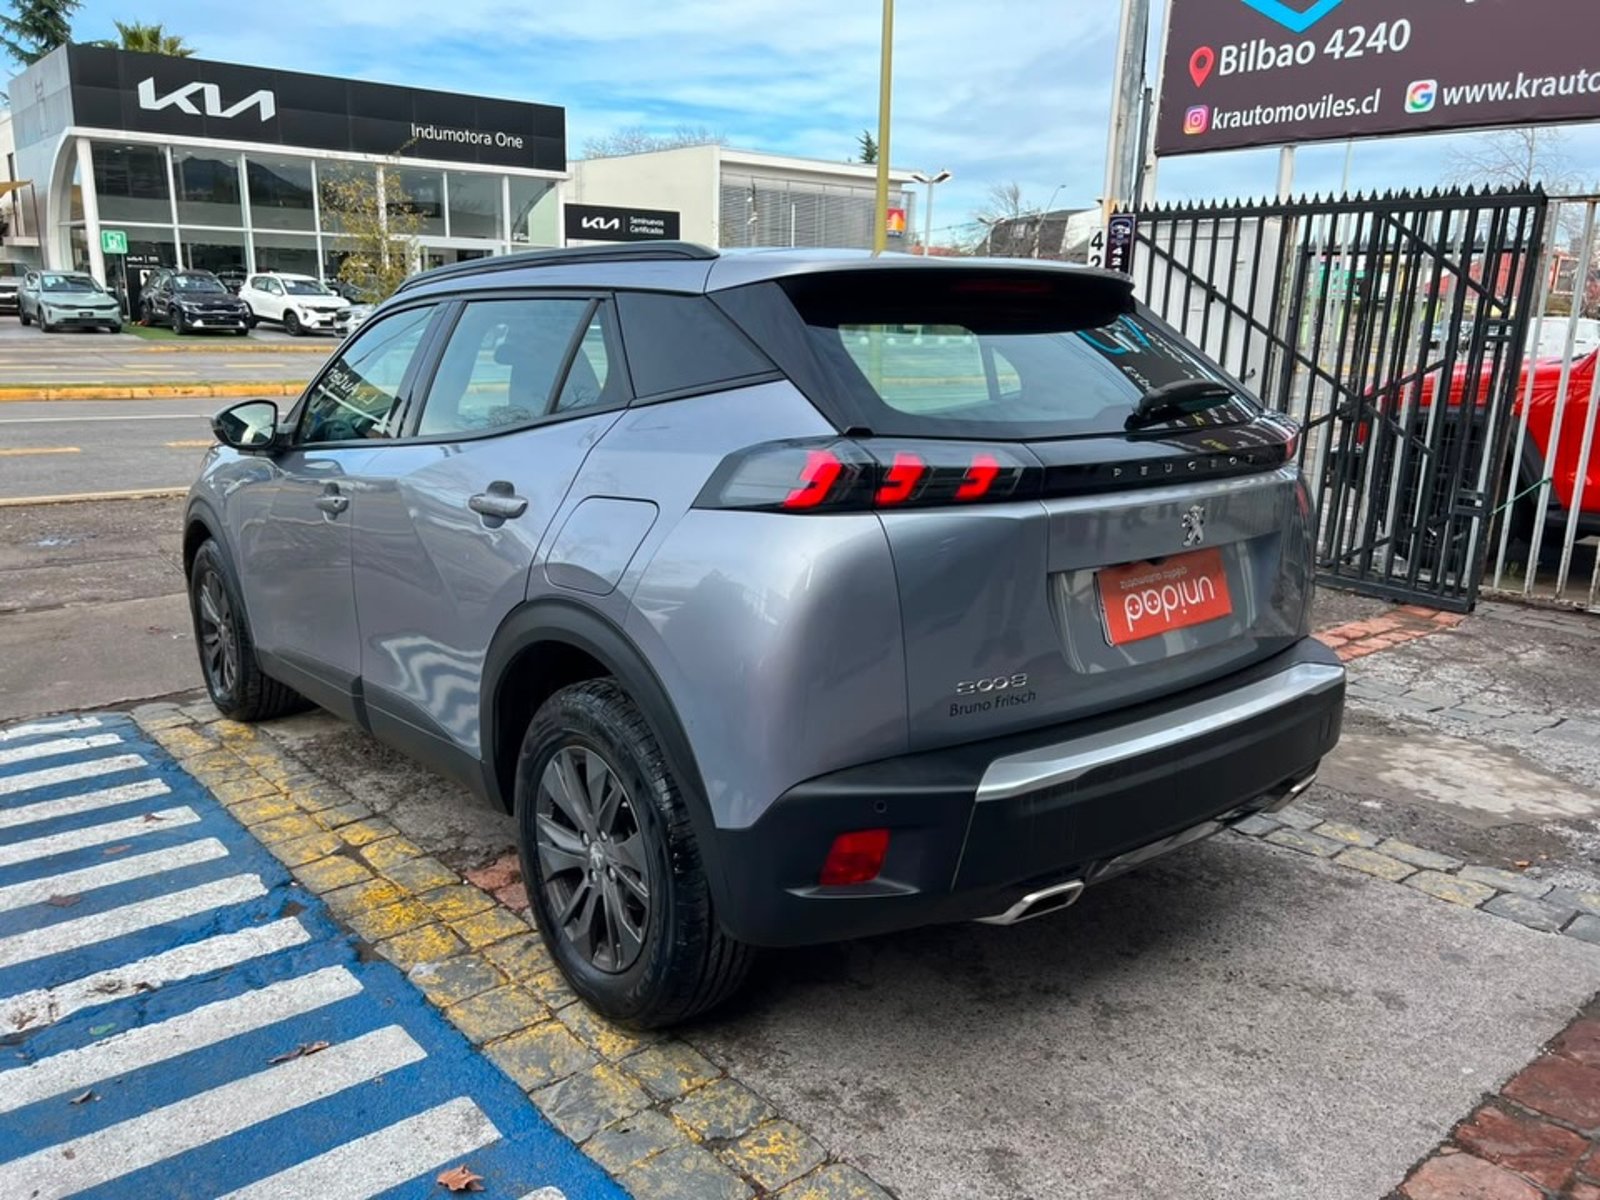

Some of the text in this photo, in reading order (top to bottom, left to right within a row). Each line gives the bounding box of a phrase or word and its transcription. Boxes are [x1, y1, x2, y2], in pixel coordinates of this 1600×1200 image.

[1219, 18, 1411, 76] Bilbao 4240
[1211, 88, 1382, 130] krautomoviles.cl
[410, 122, 523, 149] Indumotora One
[1112, 454, 1256, 477] PEUGEOT
[1124, 575, 1215, 633] unidad
[956, 672, 1028, 695] 2008
[949, 691, 1037, 717] Bruno Fritsch
